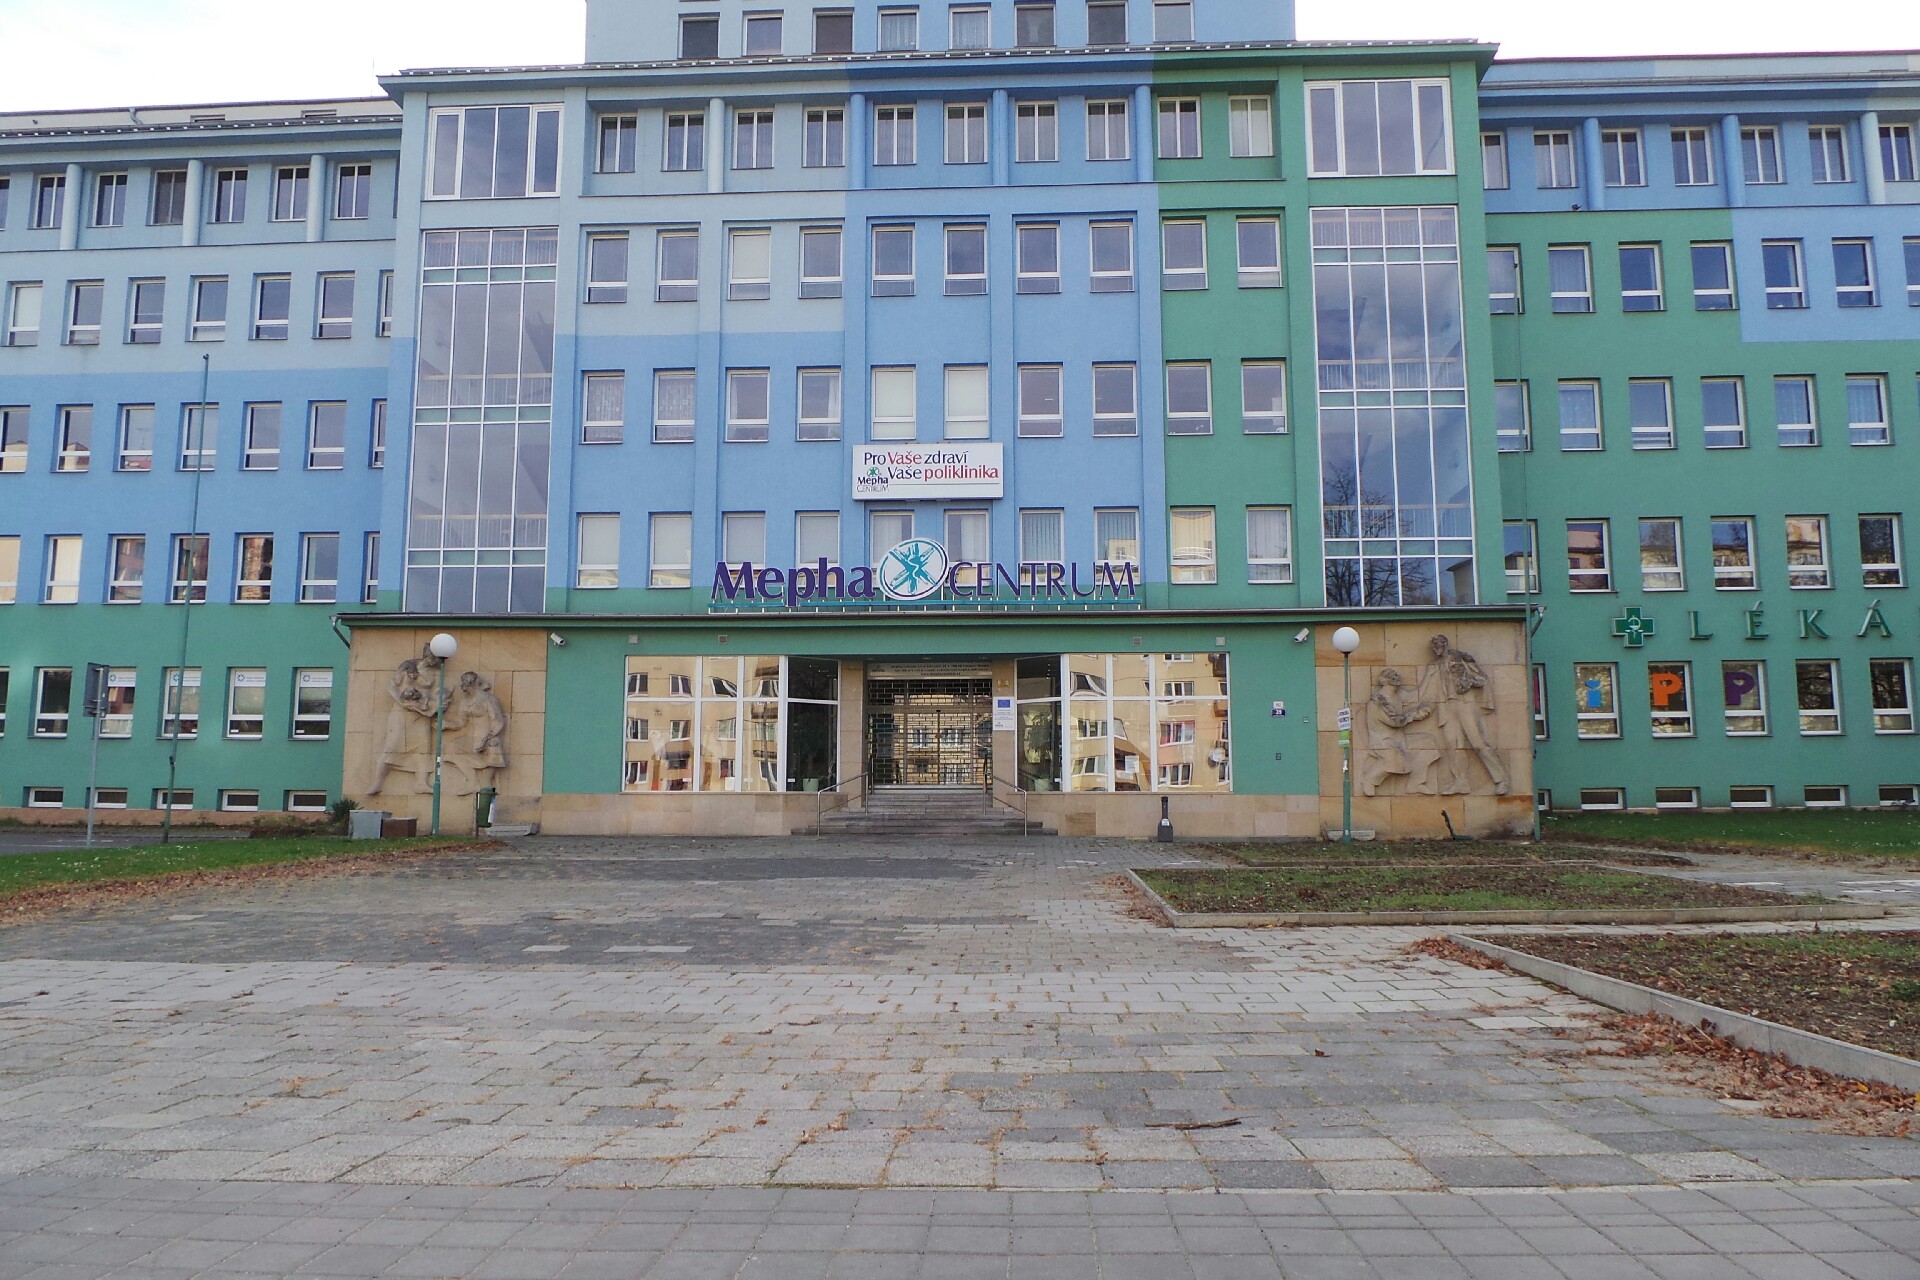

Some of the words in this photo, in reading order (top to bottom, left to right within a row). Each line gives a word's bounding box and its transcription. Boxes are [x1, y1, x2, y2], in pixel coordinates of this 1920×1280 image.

[864, 452, 886, 465] Pro
[887, 451, 922, 465] Vaše
[924, 450, 969, 465] zdraví
[857, 476, 889, 486] Mepha
[887, 465, 922, 480] Vaše
[924, 465, 999, 482] poliklinika
[711, 557, 876, 607] Mepha
[950, 561, 1136, 597] CENTRUM
[1688, 599, 1920, 640] LÉKÁ
